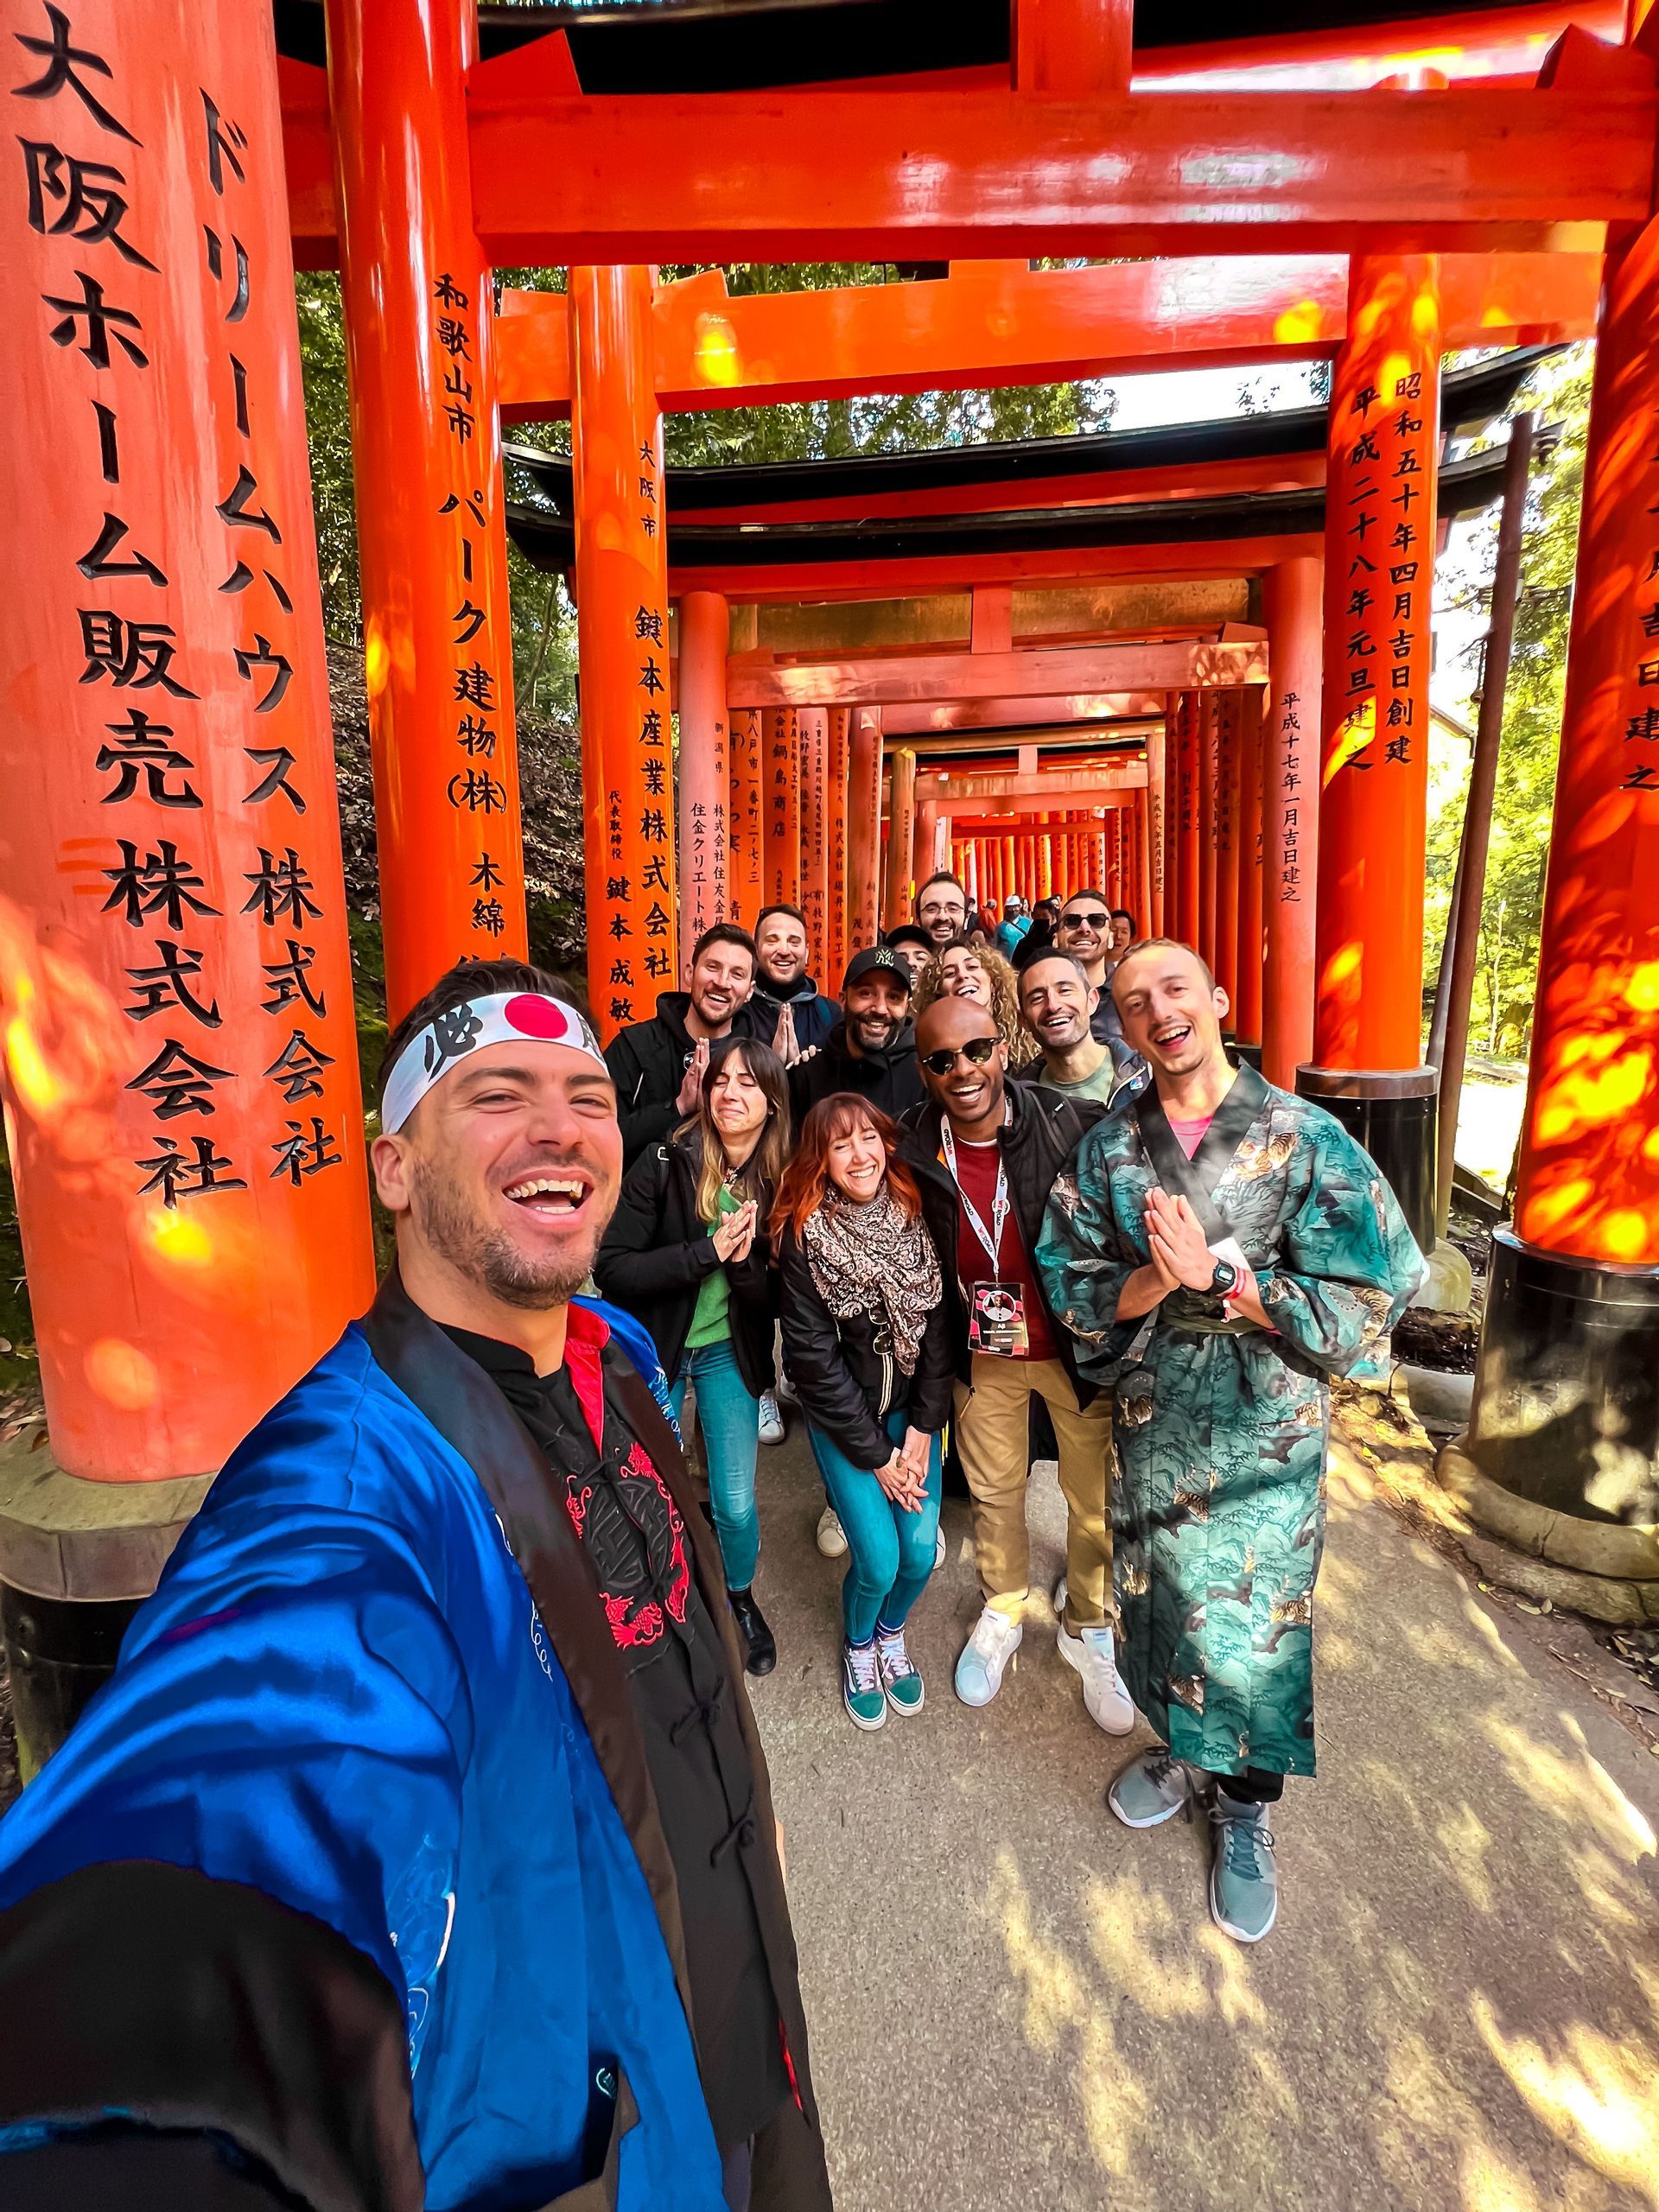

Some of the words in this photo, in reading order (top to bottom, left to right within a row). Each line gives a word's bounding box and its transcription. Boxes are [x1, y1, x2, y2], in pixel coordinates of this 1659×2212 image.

[433, 272, 475, 445] 和歌山市
[639, 440, 656, 538] 大阪市
[1344, 388, 1381, 770] 平成二十八年元旦建之
[1384, 372, 1422, 765] 昭和五十年四月吉日創建
[633, 605, 672, 980] 鍵本産業株式会社
[715, 722, 724, 774] 新潟県
[1281, 692, 1301, 902] 平成十七年一月吉日建之
